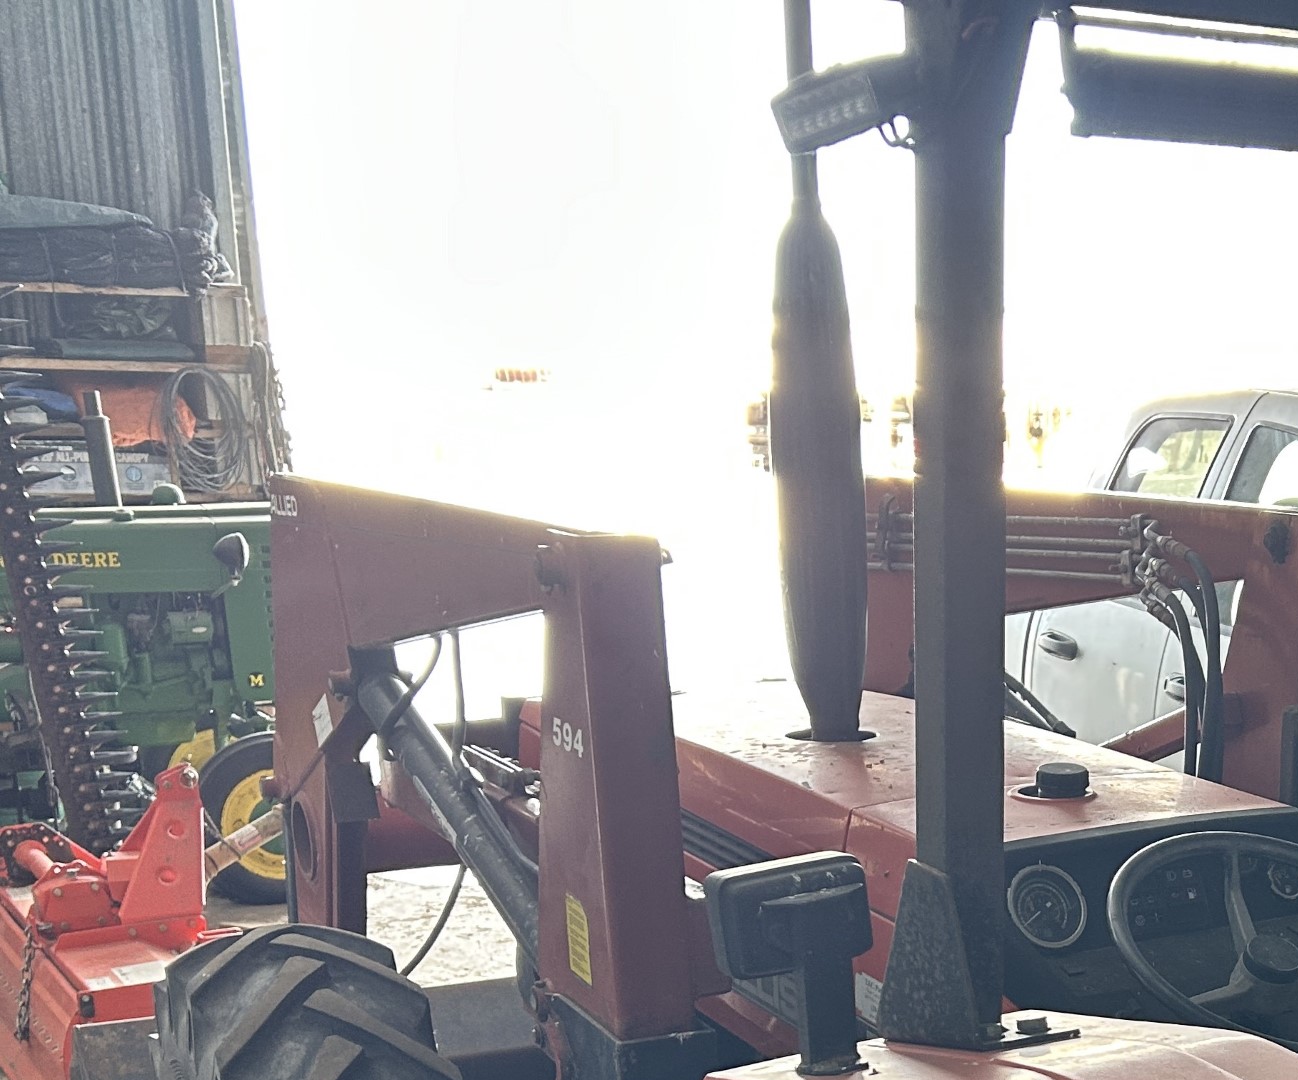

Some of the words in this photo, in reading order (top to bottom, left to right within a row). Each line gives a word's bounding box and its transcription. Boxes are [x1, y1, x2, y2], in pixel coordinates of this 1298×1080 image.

[271, 494, 298, 516] ALLIED
[52, 551, 121, 568] DEERE
[249, 673, 265, 687] M
[552, 716, 584, 758] 594
